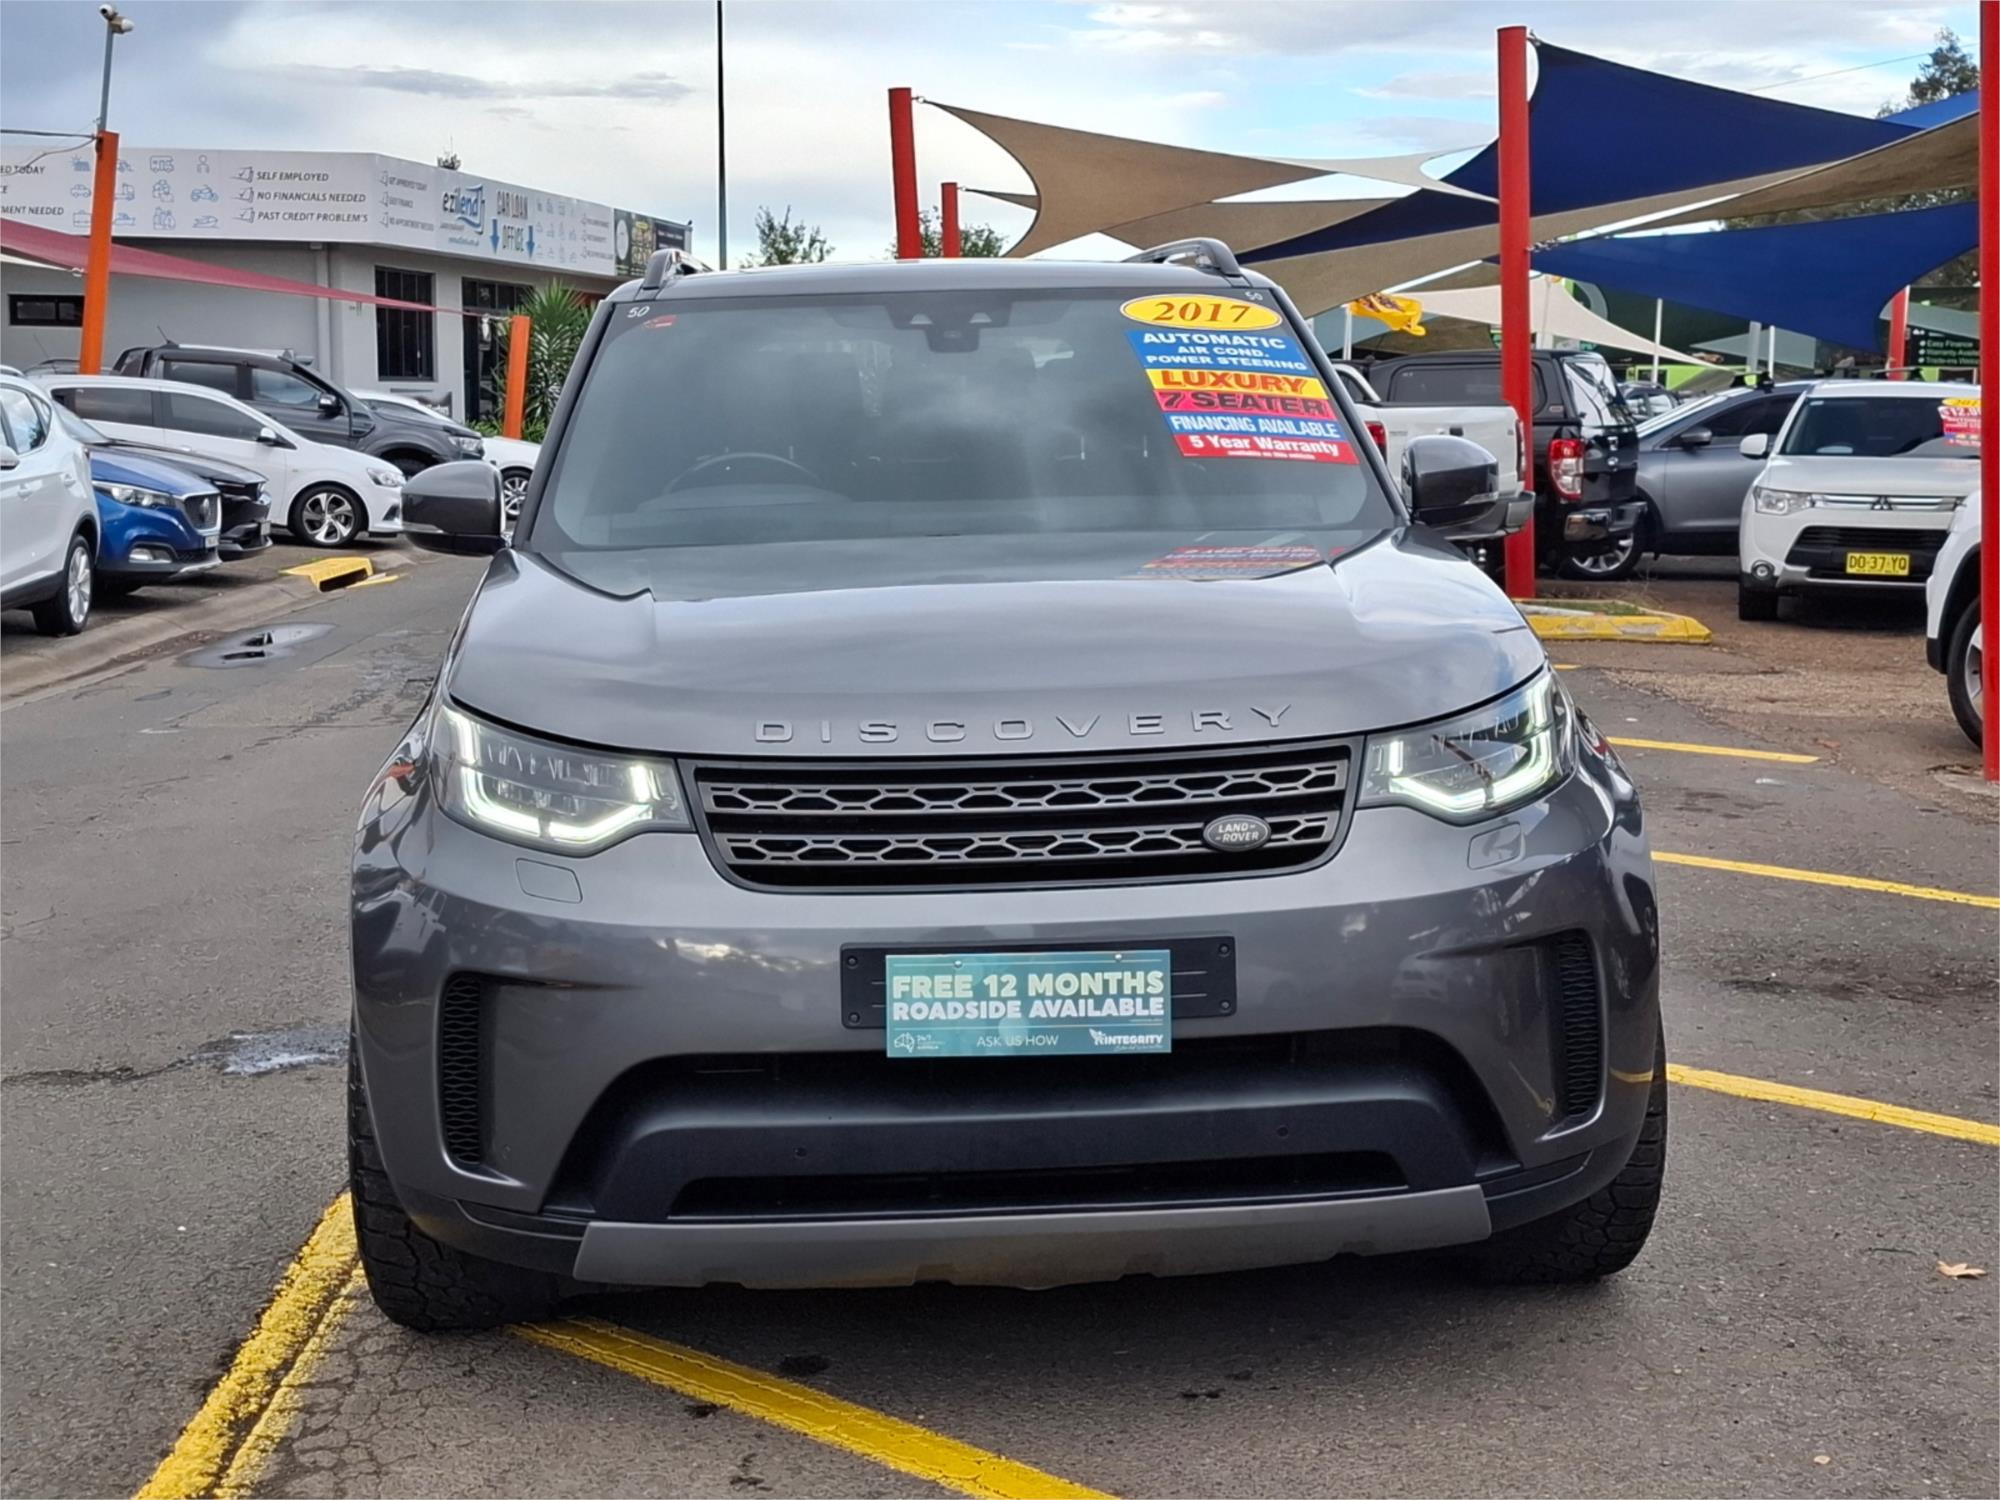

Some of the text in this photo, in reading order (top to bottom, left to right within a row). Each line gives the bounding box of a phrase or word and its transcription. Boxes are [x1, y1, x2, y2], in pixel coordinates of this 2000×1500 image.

[257, 172, 329, 181] SELF EMPLOYED
[257, 192, 366, 202] NO FINANCIALS NEEDED
[28, 206, 64, 215] NEEDED
[257, 211, 368, 222] PAST CREDIT PROBLEM'S
[627, 306, 650, 318] 50
[1153, 302, 1251, 323] 2017
[1143, 333, 1286, 349] AUTOMATIC
[1178, 346, 1270, 357] AIR COND.
[1146, 355, 1308, 371] POWER STEERING
[1161, 370, 1308, 394] LUXURY
[1159, 391, 1329, 416] 7 SEATER
[1170, 416, 1341, 438] FINANCING AVAILABLE
[1189, 435, 1204, 448] 5
[1208, 435, 1250, 449] Year
[1254, 437, 1339, 457] Warranty
[755, 704, 1292, 743] DISCOVERY
[893, 971, 1165, 999] FREE 12 MONTHS
[893, 996, 1164, 1021] ROADSIDE AVAILABLE
[976, 1034, 1059, 1047] ASK US HOW
[1104, 1034, 1163, 1046] INTEGRITY
